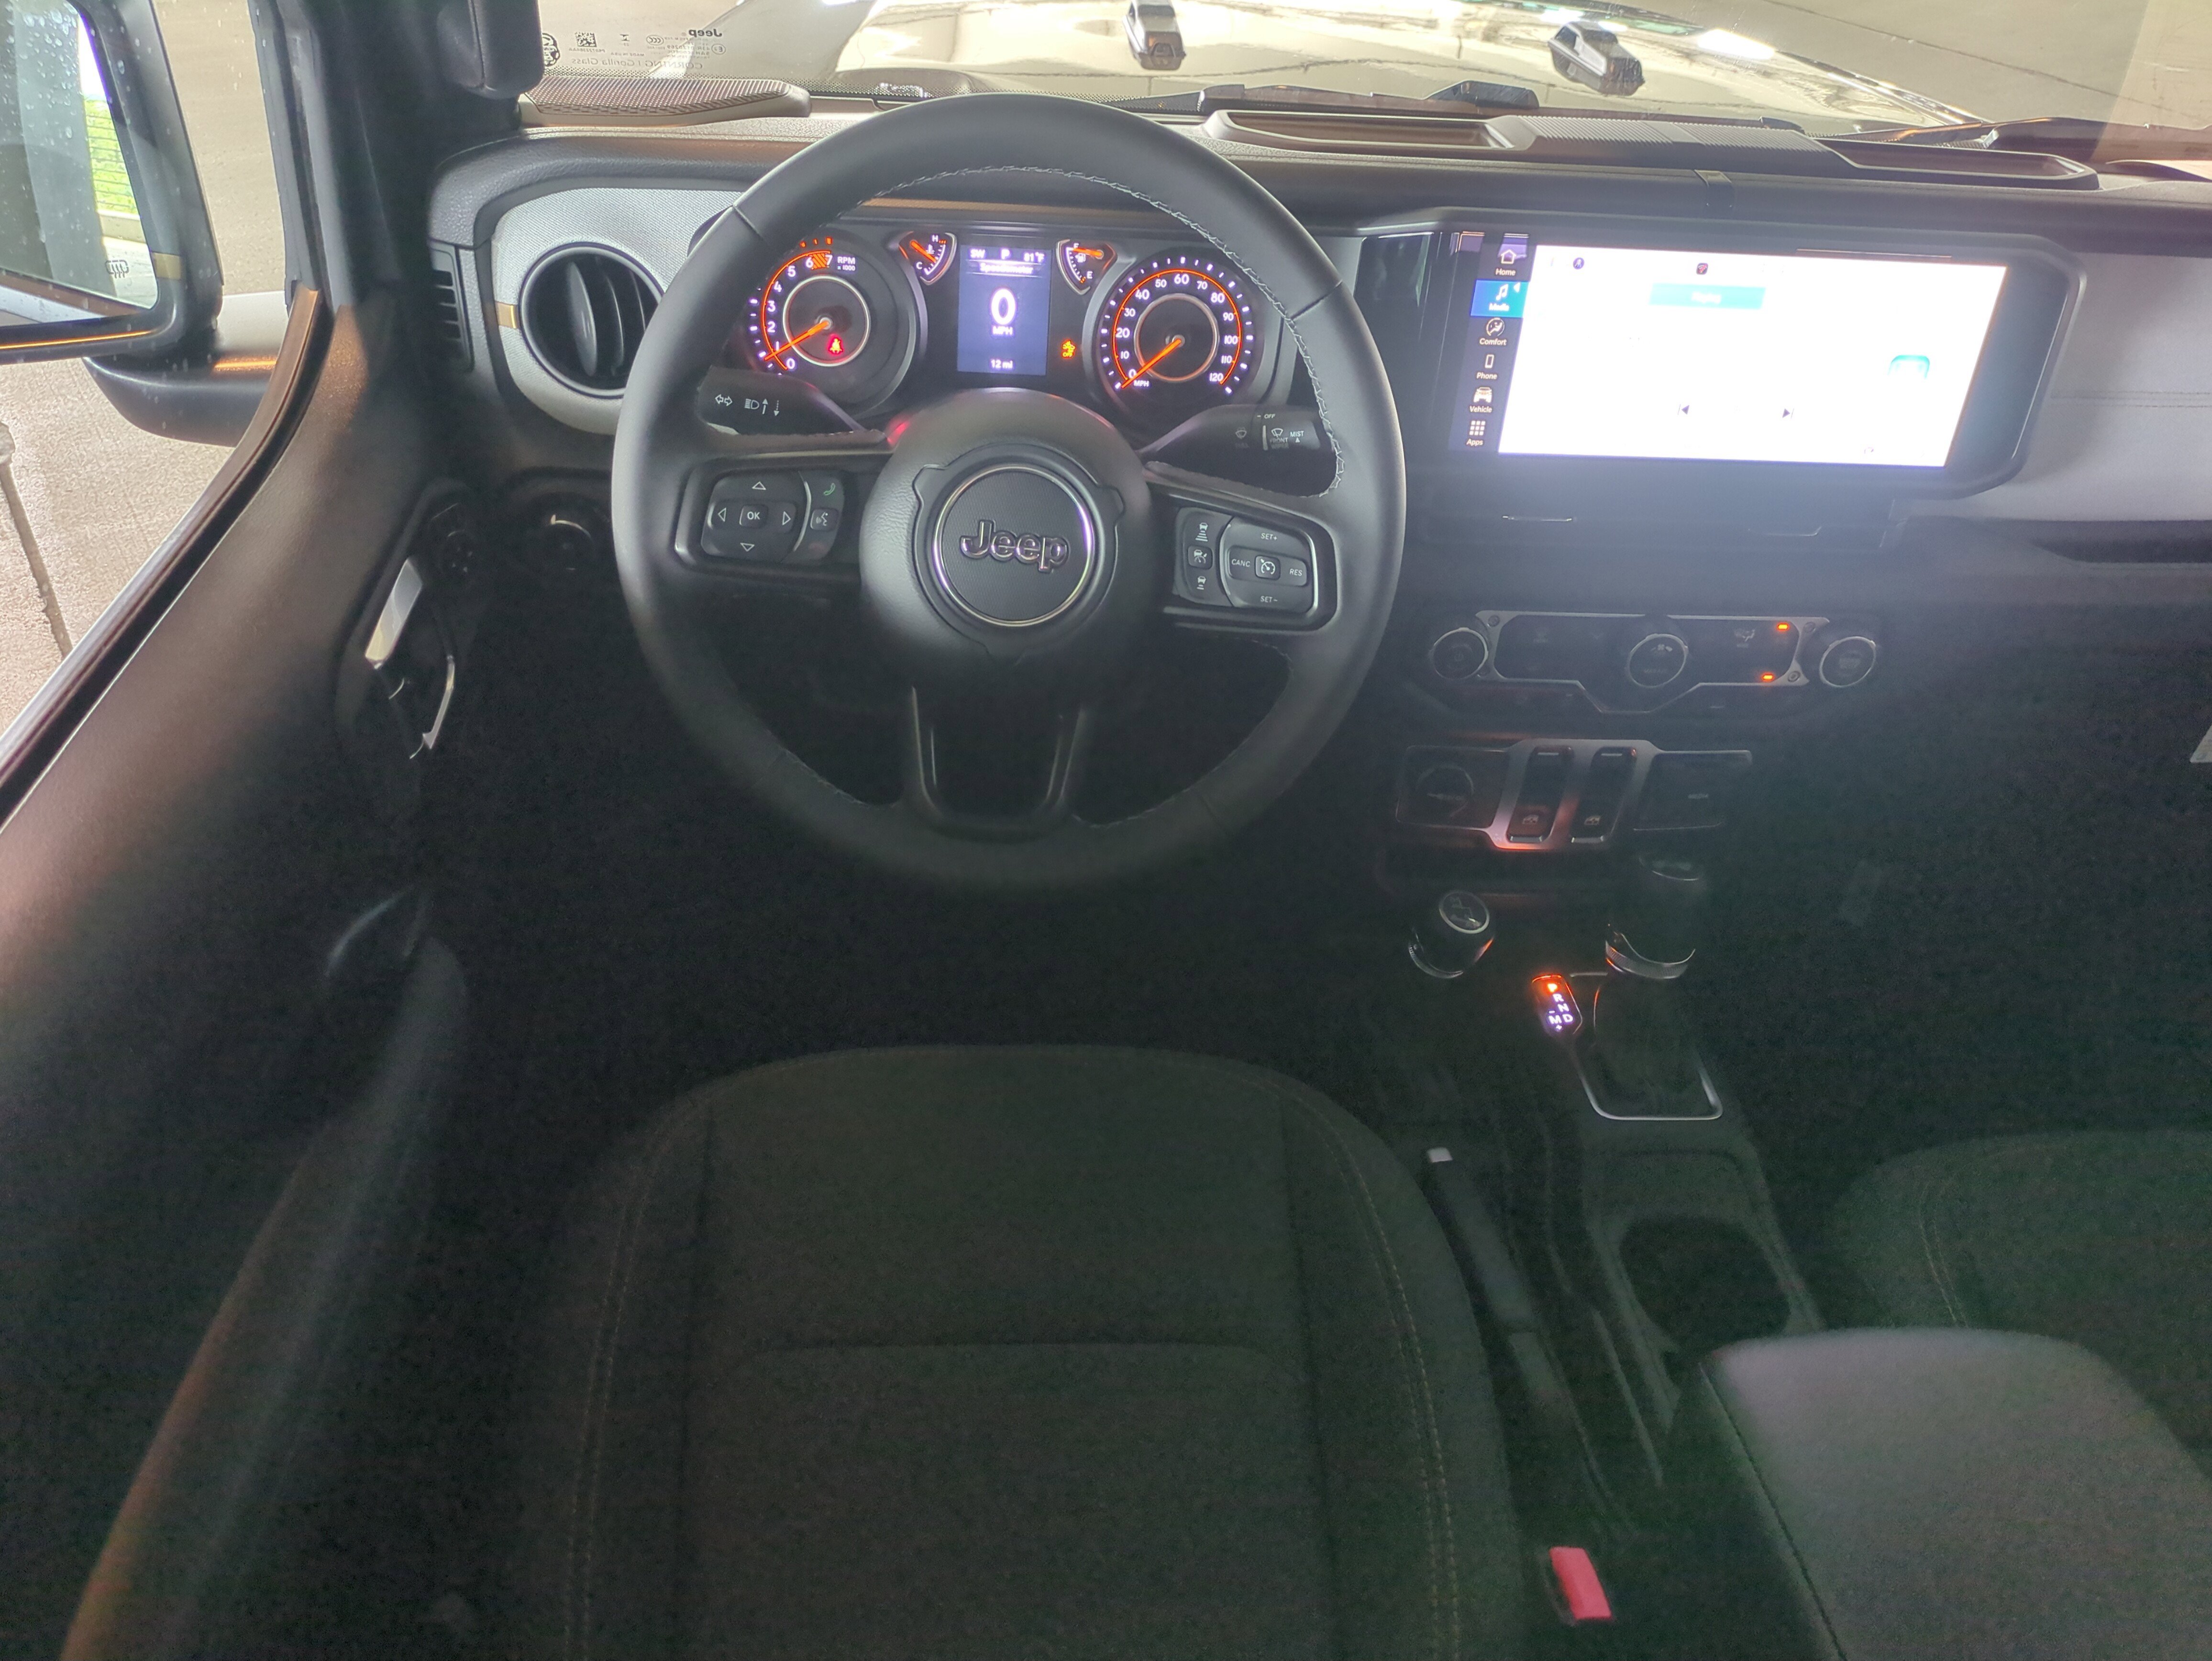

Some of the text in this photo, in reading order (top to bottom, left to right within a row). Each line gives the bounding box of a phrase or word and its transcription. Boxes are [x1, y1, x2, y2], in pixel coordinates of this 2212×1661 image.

[970, 249, 985, 258] SW
[1001, 249, 1010, 259] P
[806, 257, 813, 268] 6
[826, 255, 833, 266] 7
[916, 261, 923, 269] C
[788, 266, 796, 277] 5
[1086, 271, 1093, 279] E
[1155, 278, 1167, 288] 50
[1174, 274, 1190, 284] 60
[774, 280, 782, 292] 4
[1197, 280, 1208, 289] 70
[1135, 289, 1150, 300] 40
[1211, 292, 1225, 303] 80
[767, 300, 776, 312] 3
[991, 288, 1016, 325] 0
[1124, 308, 1136, 317] 30
[1223, 312, 1234, 321] 90
[767, 321, 775, 332] 2
[993, 326, 1013, 335] MPH
[1116, 327, 1130, 338] 20
[1224, 335, 1238, 344] 100
[1479, 337, 1507, 345] Comfort
[1120, 351, 1130, 359] 10
[1221, 355, 1233, 364] 110
[786, 358, 795, 369] 0
[991, 359, 1013, 368] 12 mi
[1128, 369, 1137, 379] 0
[1209, 373, 1224, 382] 120
[1466, 438, 1483, 447] Apps
[747, 511, 760, 520] OK
[960, 520, 1070, 574] Jeep
[1231, 559, 1250, 567] CANC
[1289, 568, 1303, 576] RES
[1547, 983, 1558, 993] P
[1553, 994, 1564, 1002] R
[1557, 1003, 1569, 1012] N
[1548, 1014, 1573, 1024] M D
